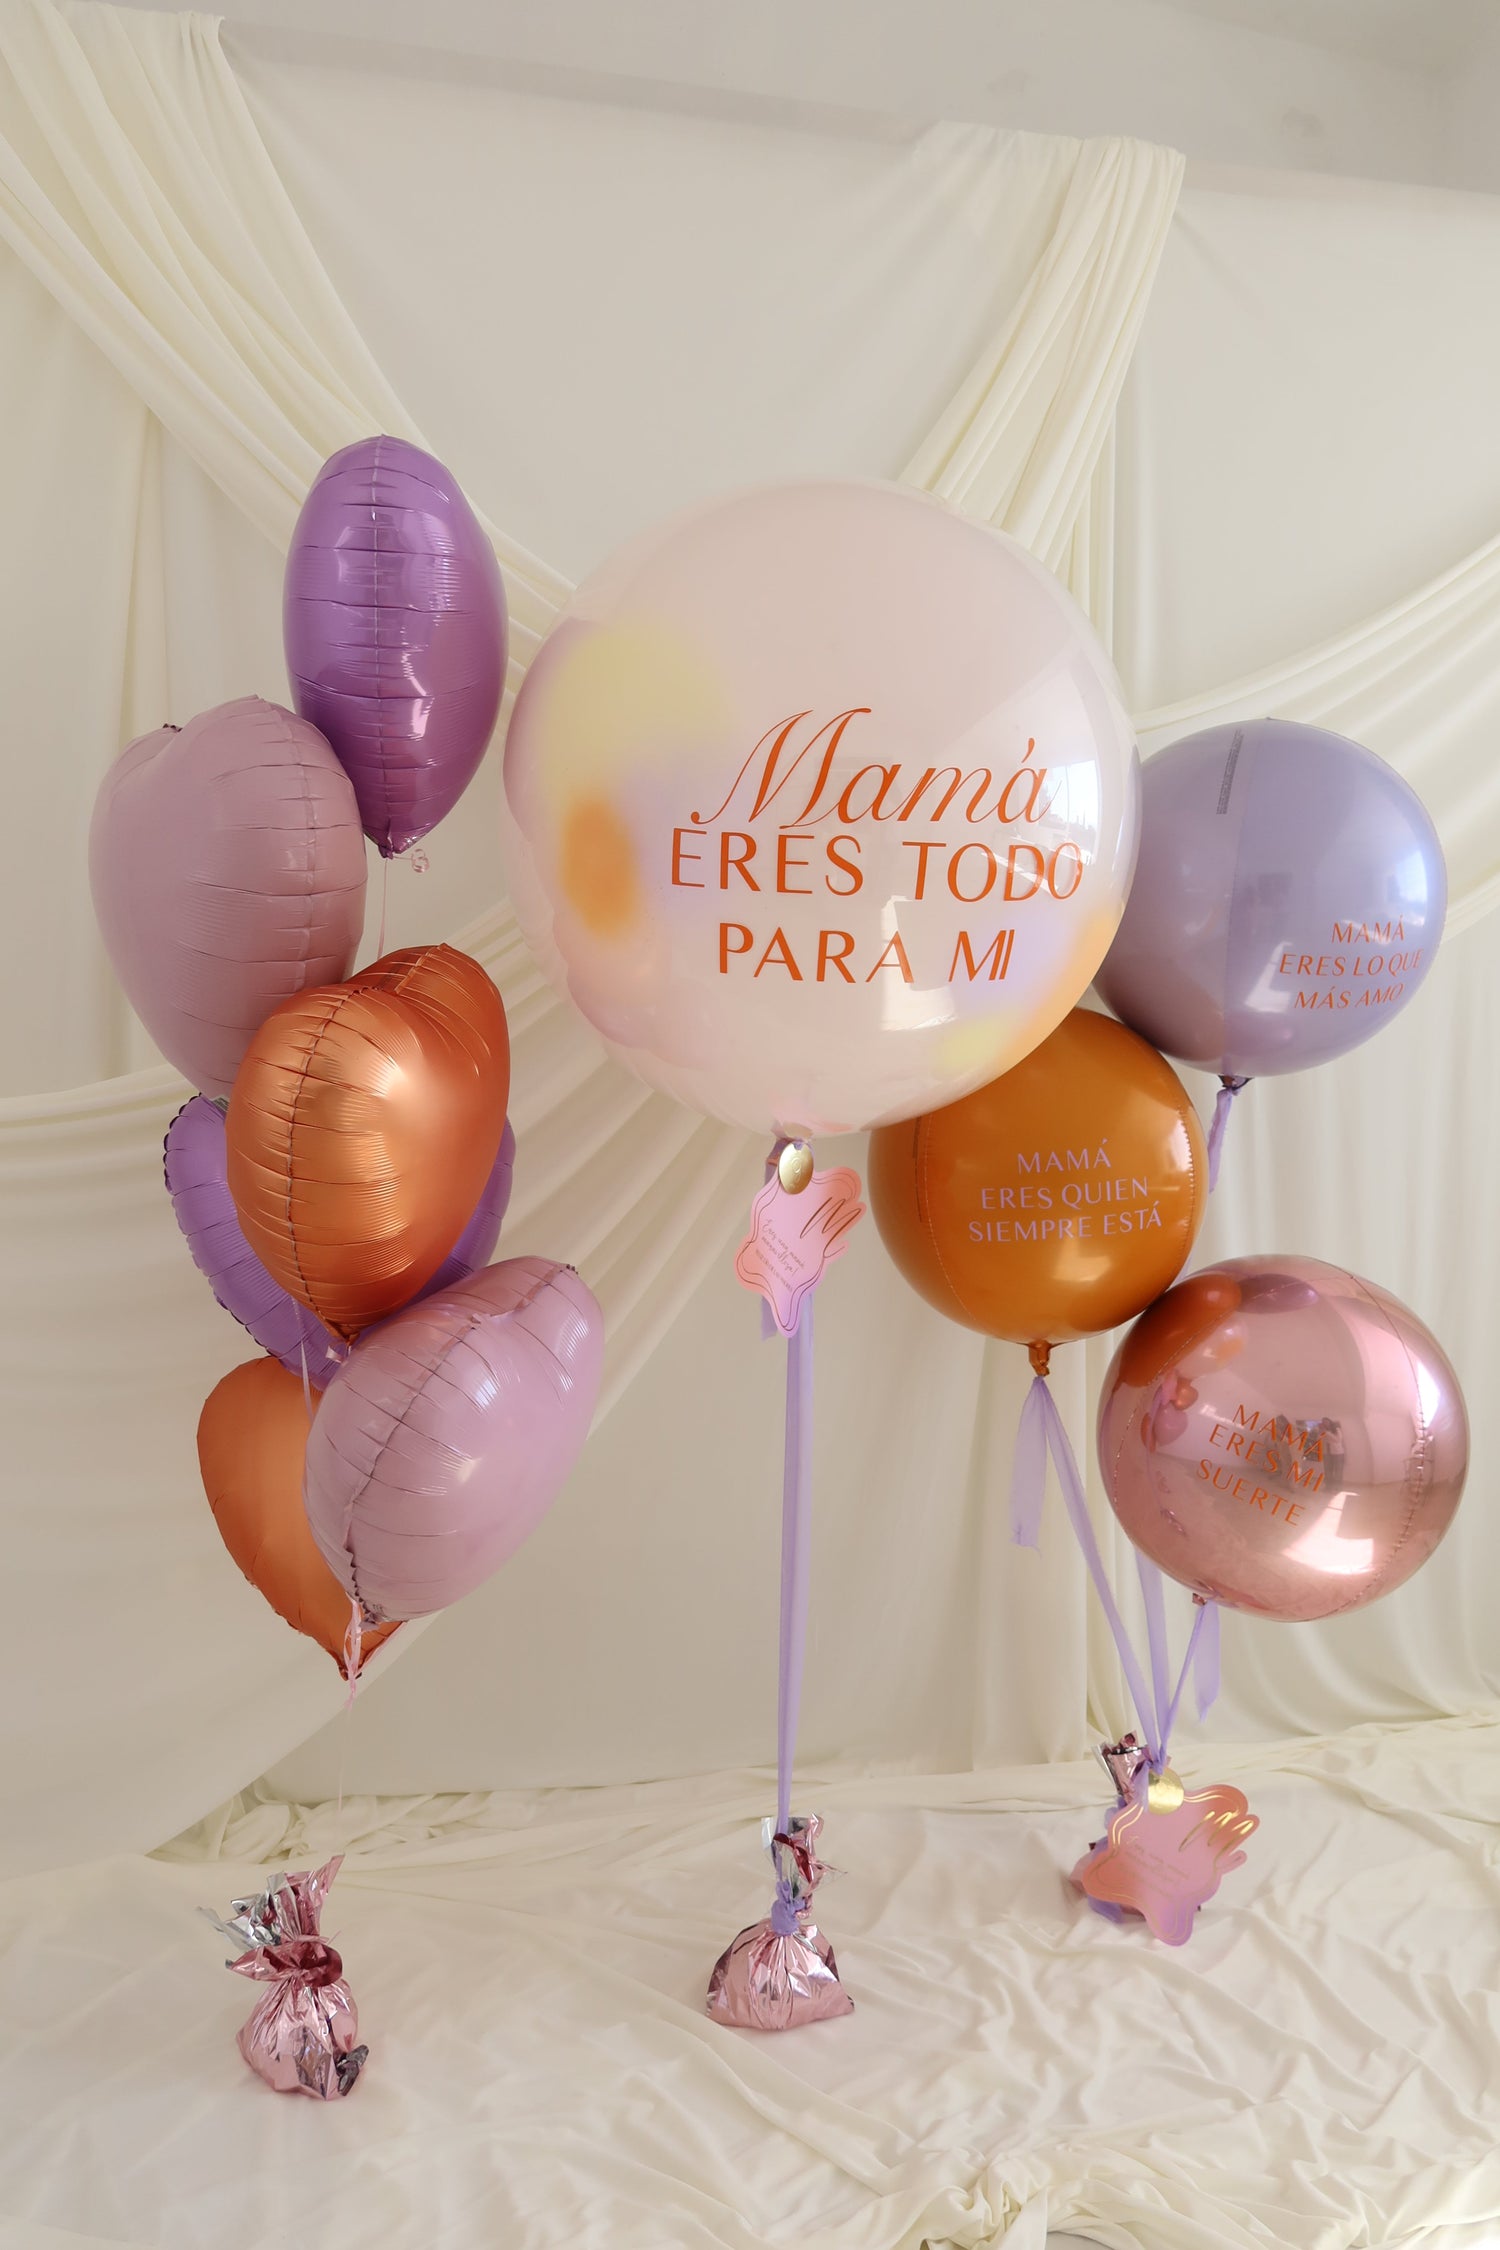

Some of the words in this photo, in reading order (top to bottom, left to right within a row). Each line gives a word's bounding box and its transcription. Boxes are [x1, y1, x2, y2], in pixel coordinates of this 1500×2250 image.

[690, 707, 1062, 829] Mamá
[671, 828, 864, 896] ERES
[902, 841, 1084, 902] TODO
[719, 922, 914, 984] PARA
[948, 929, 1015, 983] MI
[1331, 915, 1405, 945] MAMÁ
[1279, 953, 1345, 977] ERES
[1352, 954, 1384, 977] LO
[1388, 949, 1422, 975] QUE
[1294, 986, 1351, 1010] MÁS
[1355, 983, 1405, 1009] AMO
[1017, 1138, 1112, 1175] MAMÁ
[981, 1186, 1053, 1210] ERES
[1061, 1176, 1149, 1210] QUIEN
[968, 1216, 1093, 1243] SIEMPRE
[1103, 1200, 1163, 1236] ESTÁ
[1209, 1423, 1281, 1473] ERES
[1287, 1460, 1325, 1493] MI
[1232, 1404, 1327, 1462] MAMÁ
[1195, 1458, 1306, 1526] SUERTE
